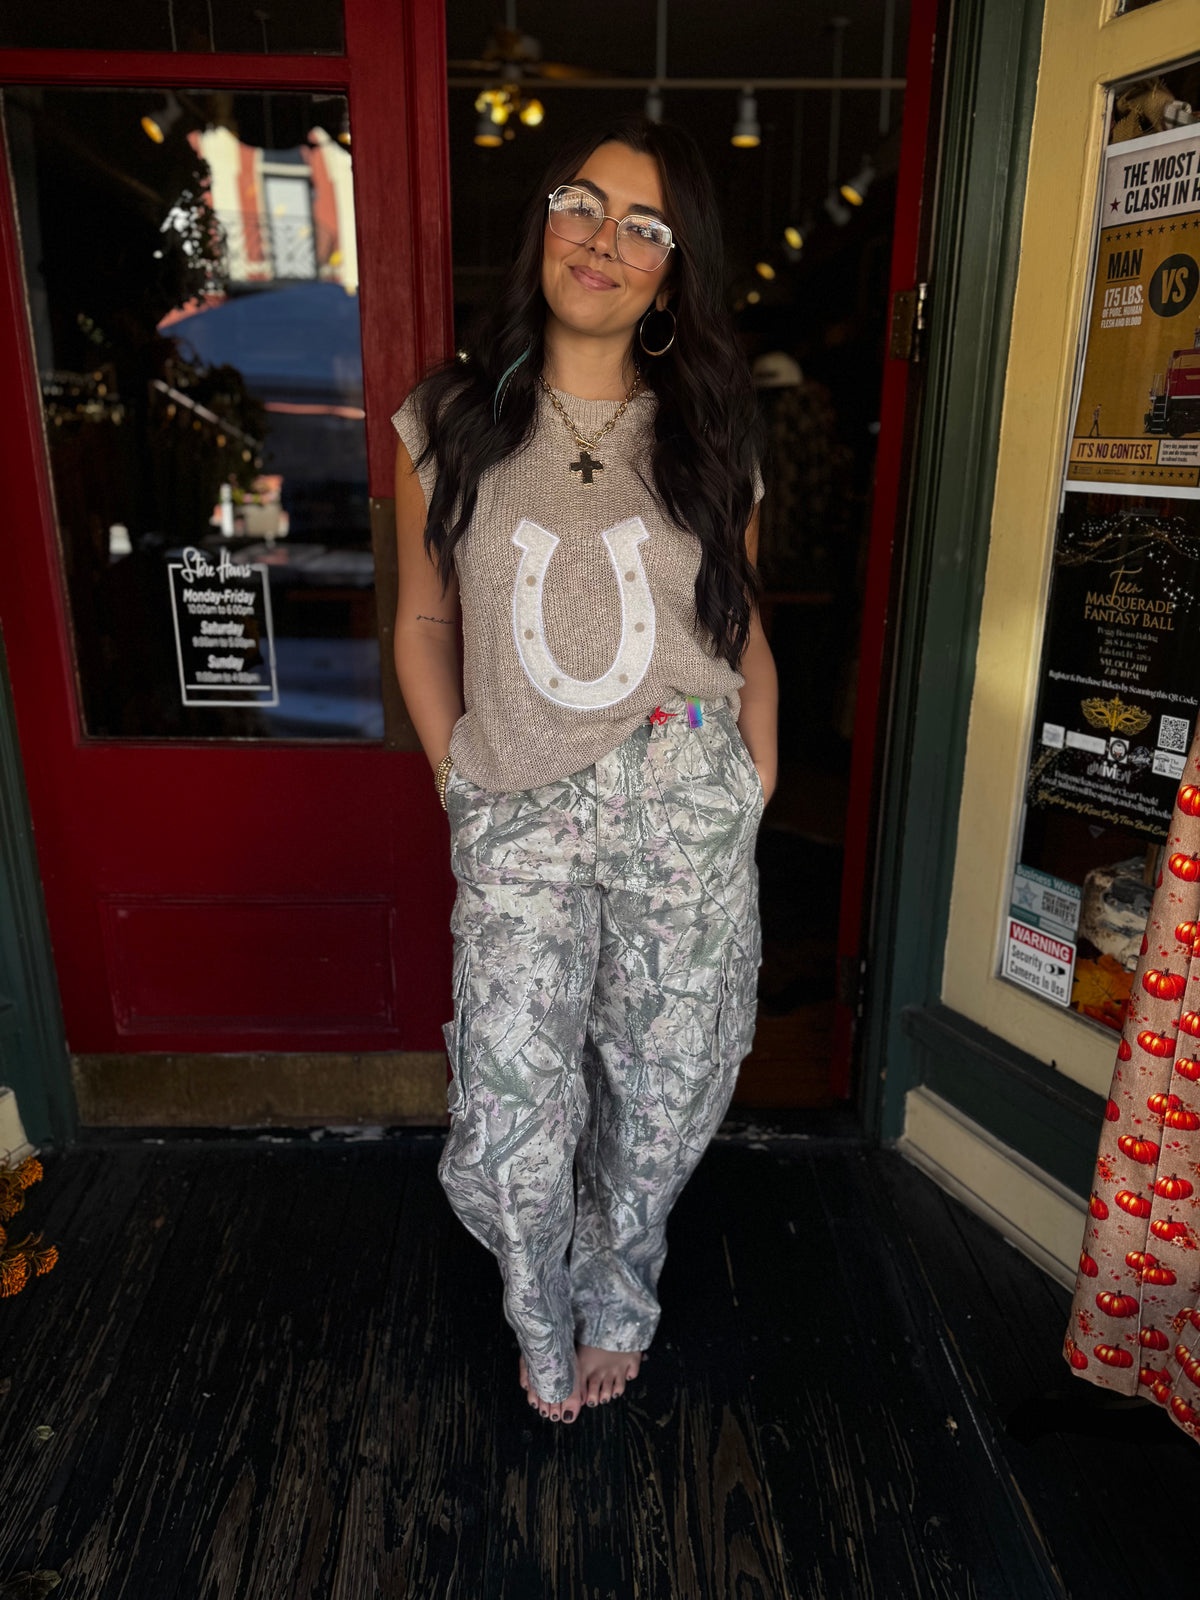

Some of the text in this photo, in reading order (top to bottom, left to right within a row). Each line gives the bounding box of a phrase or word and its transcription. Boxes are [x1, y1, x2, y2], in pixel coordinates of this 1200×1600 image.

[1124, 161, 1150, 189] THE
[1151, 151, 1196, 183] MOST
[1125, 183, 1171, 214] CLASH
[1172, 179, 1190, 206] IN
[1107, 248, 1143, 280] MAN
[1104, 284, 1144, 308] 175 LBS.
[1161, 266, 1189, 304] VS
[1077, 442, 1152, 460] IT'S NO CONTEST.
[181, 547, 252, 584] Store Hours
[1109, 564, 1143, 606] Teen
[1085, 591, 1174, 614] MASQUERADE
[200, 620, 245, 638] Saturday
[1084, 605, 1175, 631] FANTASY BALL
[207, 654, 244, 671] Sunday
[1168, 693, 1178, 703] QR
[1053, 878, 1081, 899] Watch
[1012, 923, 1070, 962] WARNING
[1012, 944, 1043, 972] Security
[1010, 960, 1040, 986] Cameras
[1050, 980, 1065, 998] Use
